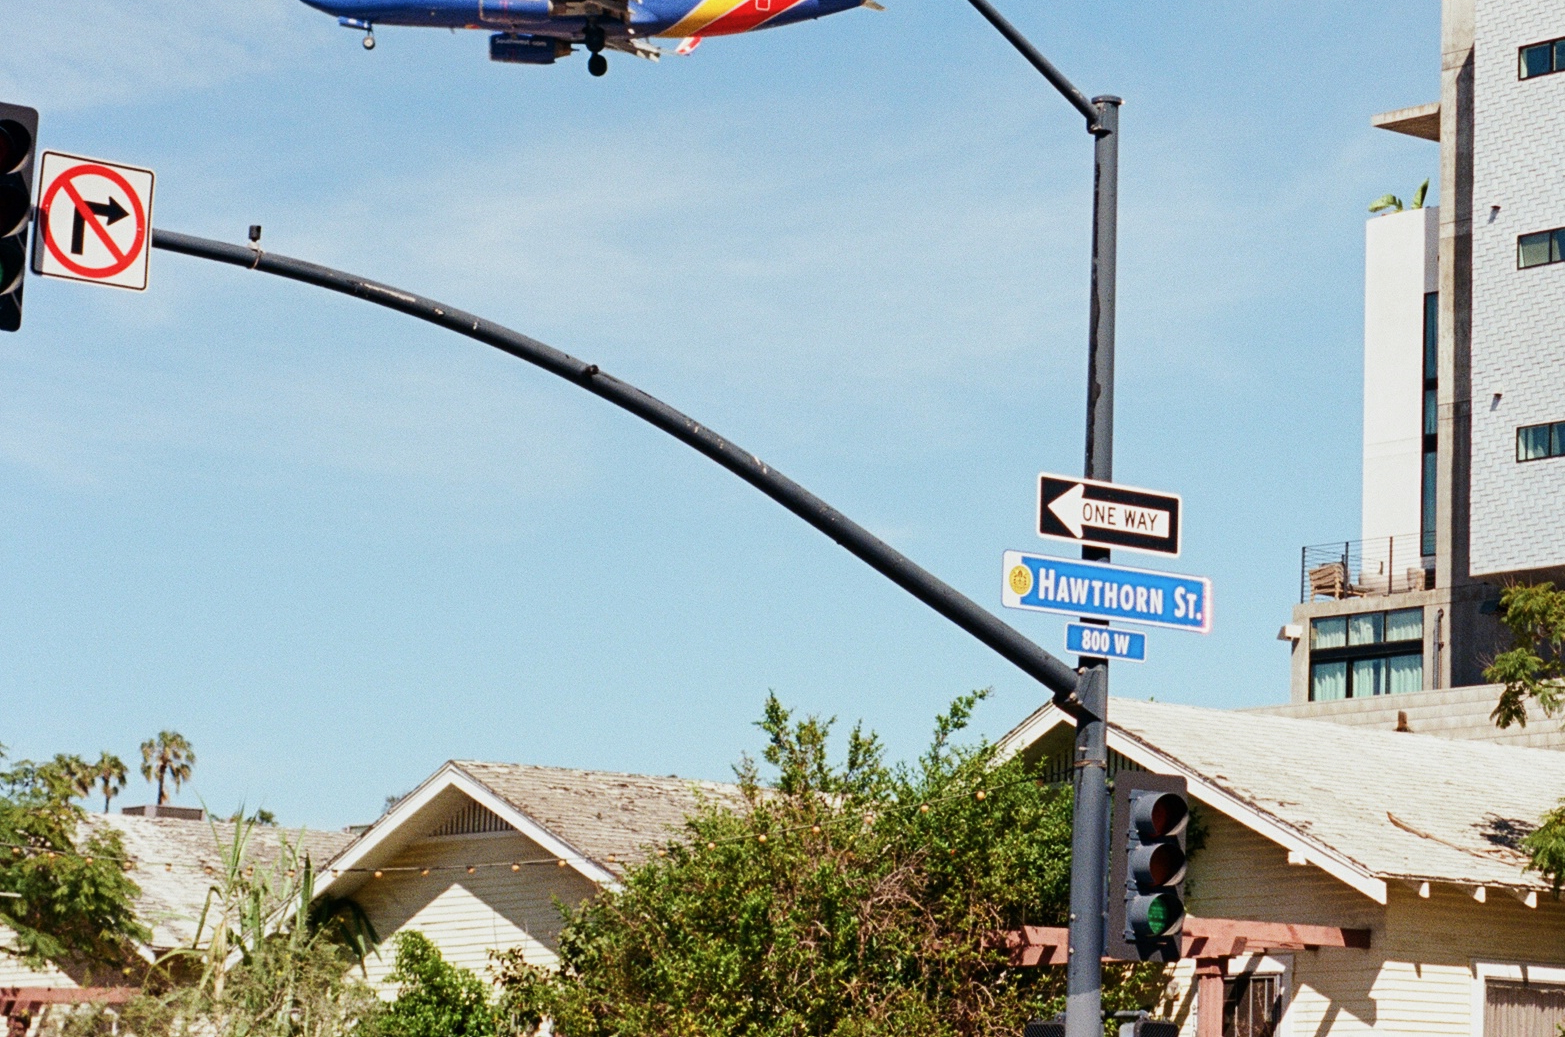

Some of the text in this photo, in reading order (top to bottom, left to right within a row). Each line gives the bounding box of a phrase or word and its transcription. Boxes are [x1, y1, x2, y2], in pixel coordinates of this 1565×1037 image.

[1082, 502, 1158, 531] ONE WAY
[1038, 567, 1202, 620] HAWTHORN ST.
[1081, 630, 1130, 655] 800 W
